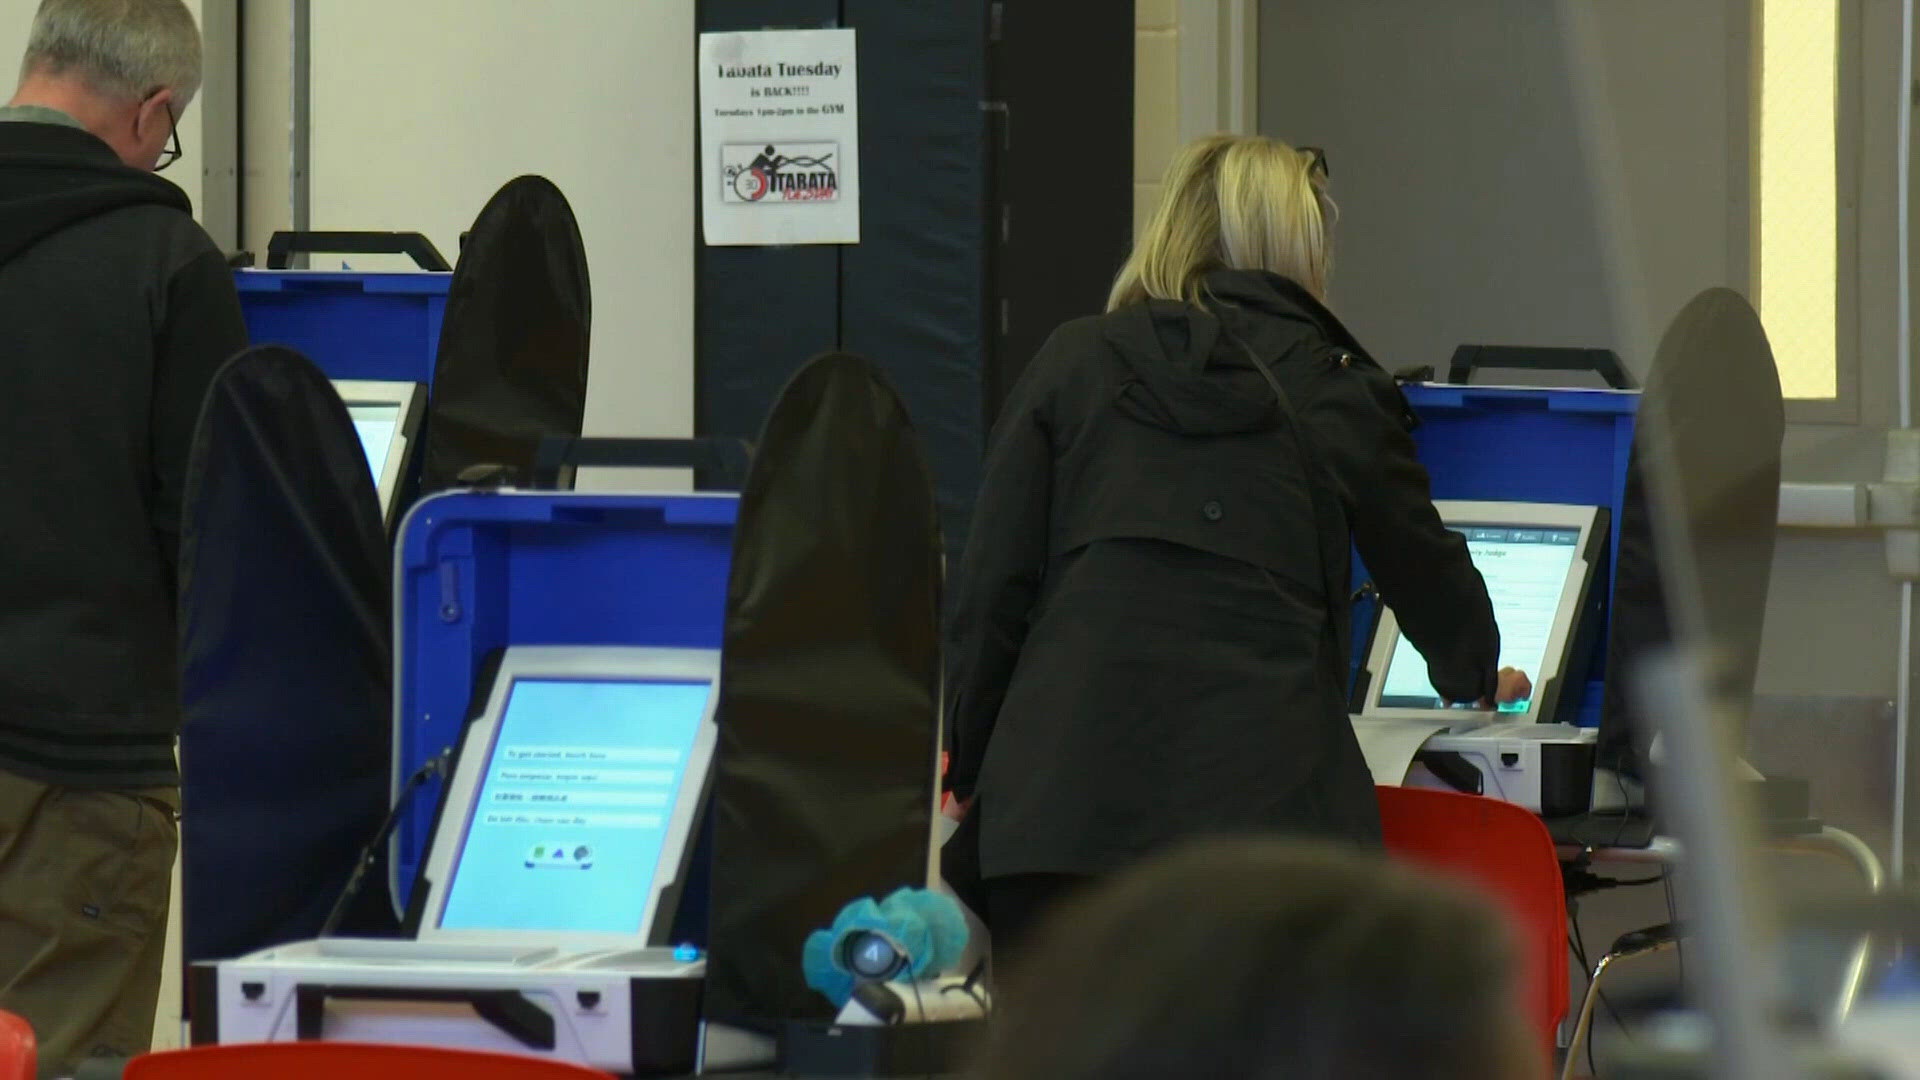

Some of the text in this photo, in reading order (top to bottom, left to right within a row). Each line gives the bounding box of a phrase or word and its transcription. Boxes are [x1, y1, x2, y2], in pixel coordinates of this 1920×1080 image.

[718, 61, 843, 79] Tabata Tuesday
[750, 86, 810, 97] is BACK!!!!
[714, 108, 754, 117] Tuesdays
[807, 107, 819, 115] the
[822, 104, 845, 115] GYM
[778, 172, 838, 191] TABATA
